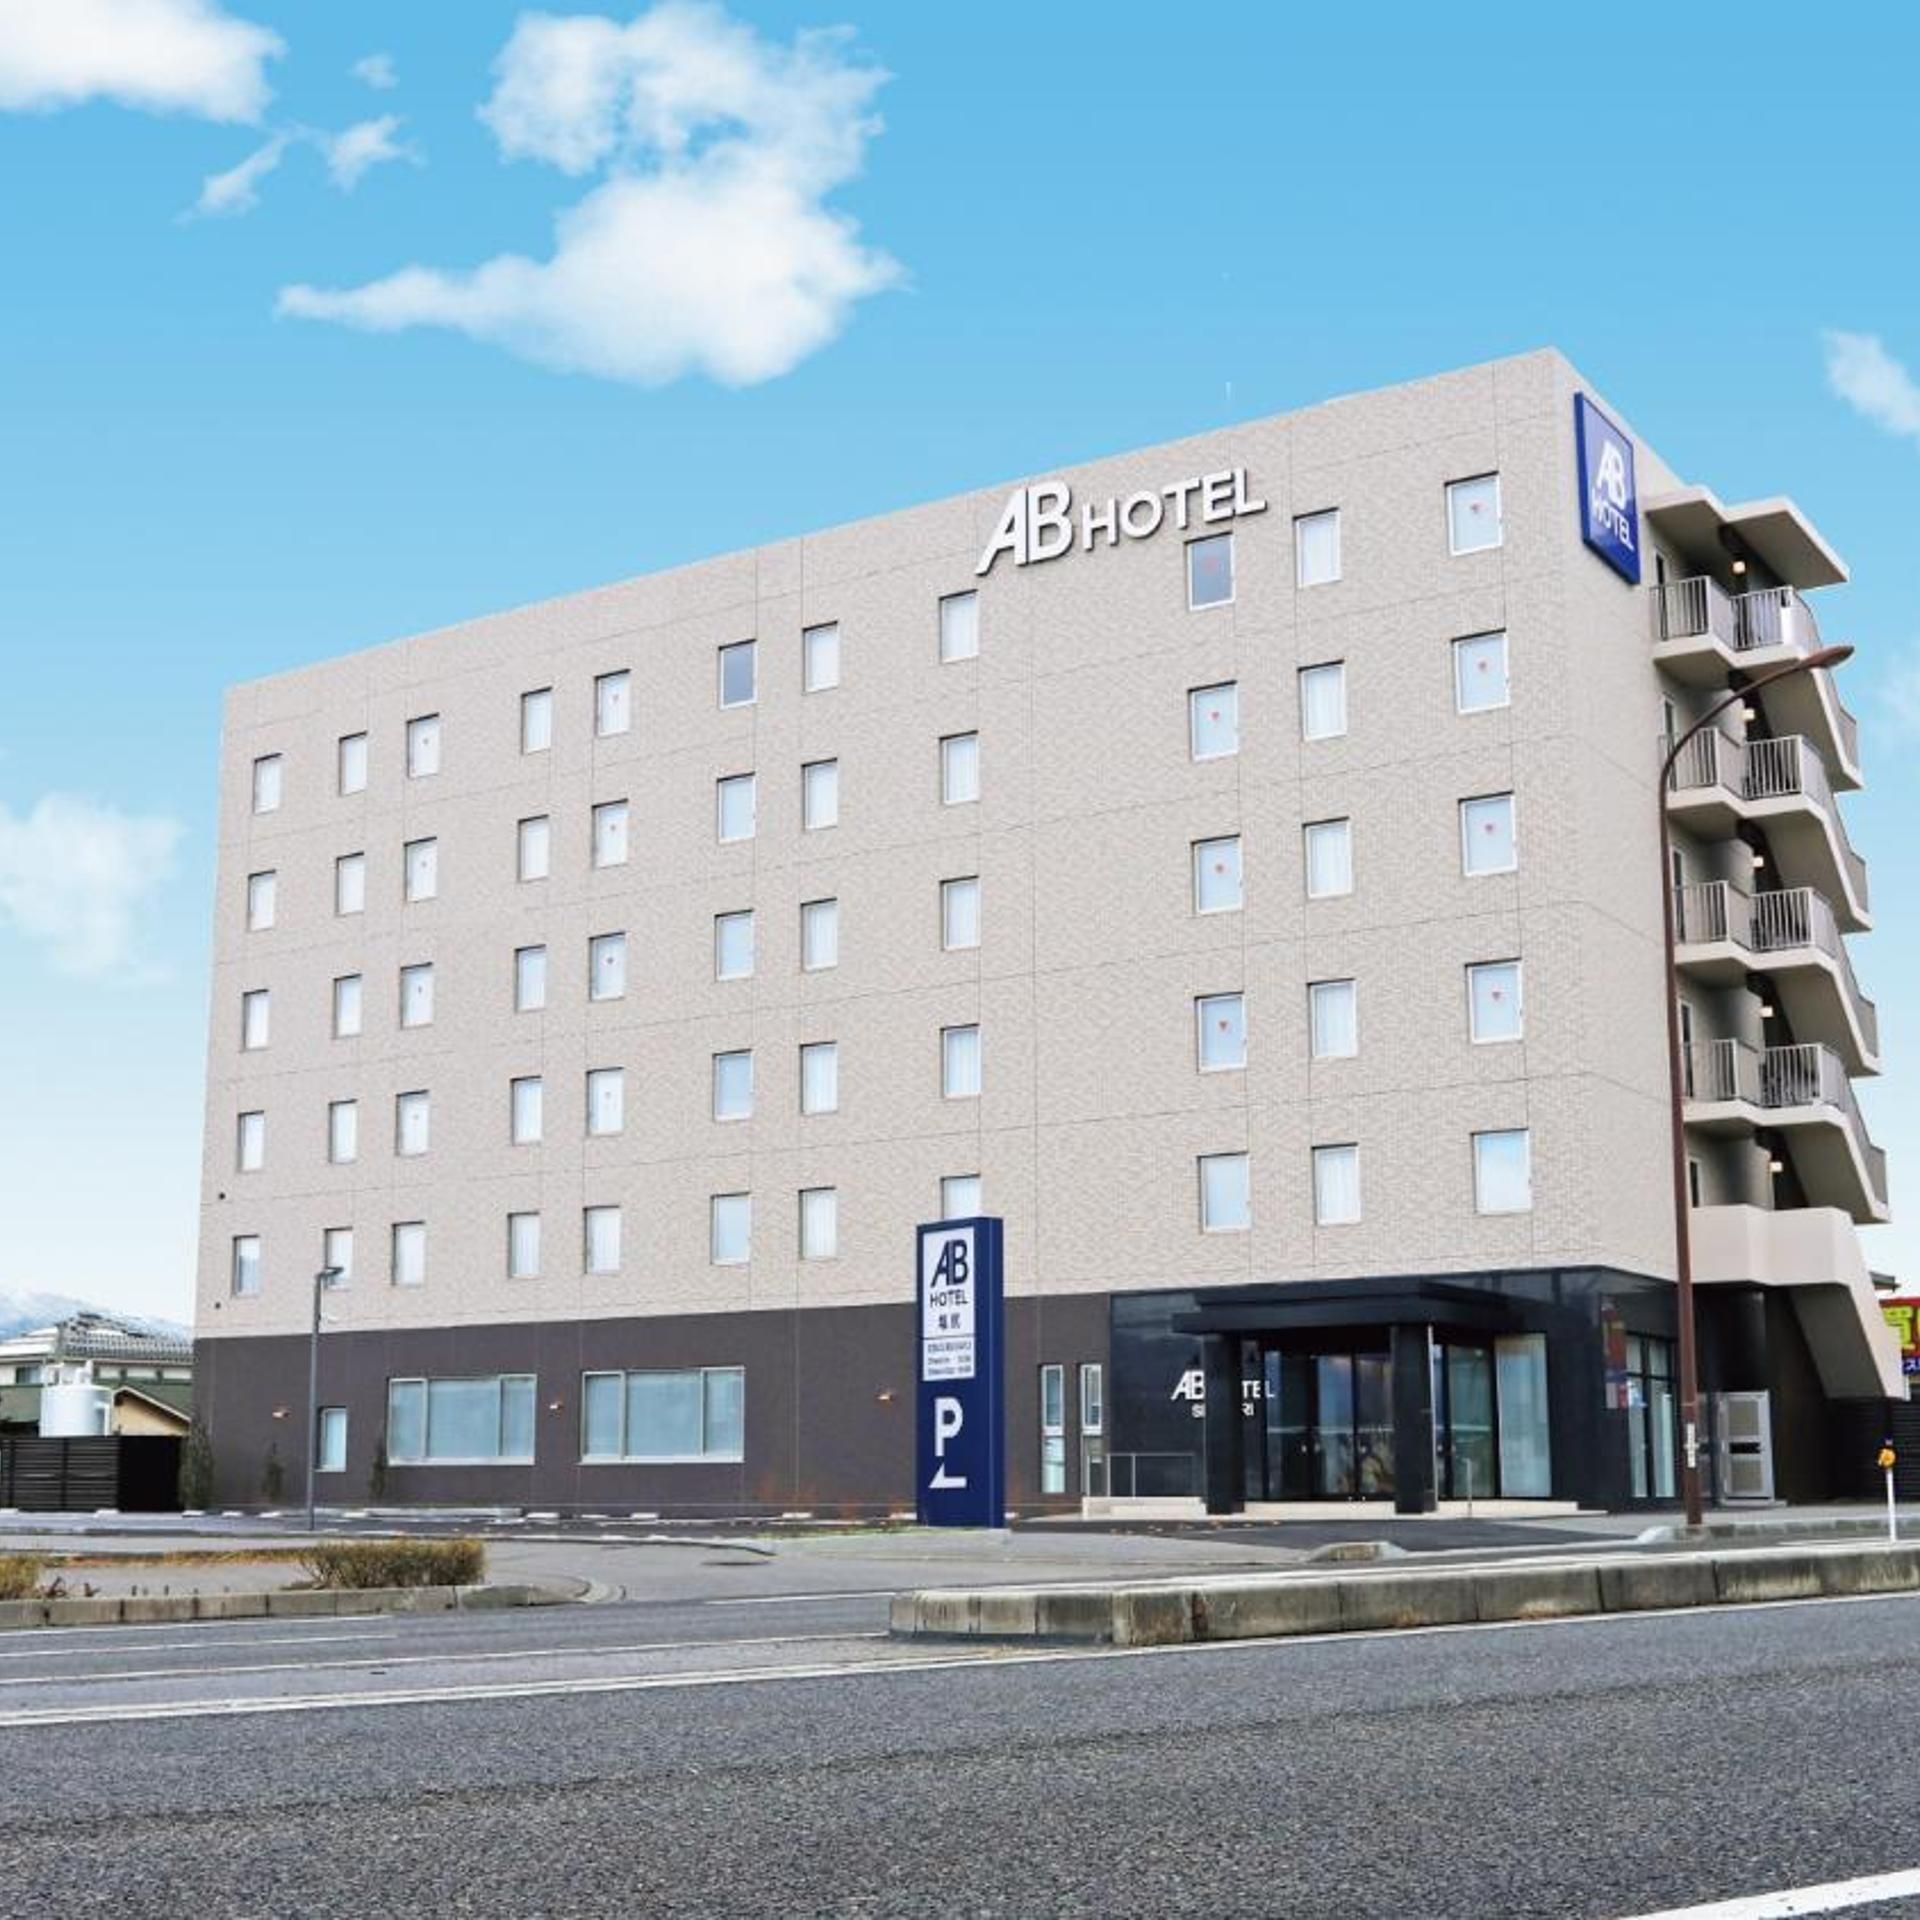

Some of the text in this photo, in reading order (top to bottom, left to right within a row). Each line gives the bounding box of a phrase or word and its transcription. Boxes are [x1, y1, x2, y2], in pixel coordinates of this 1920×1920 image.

[1597, 439, 1626, 511] AB
[975, 467, 1268, 576] AB HOTEL
[1592, 486, 1635, 553] HOTEL
[930, 1239, 969, 1288] AB
[930, 1289, 969, 1308] HOTEL
[1170, 1369, 1206, 1401] AB
[934, 1397, 964, 1457] P
